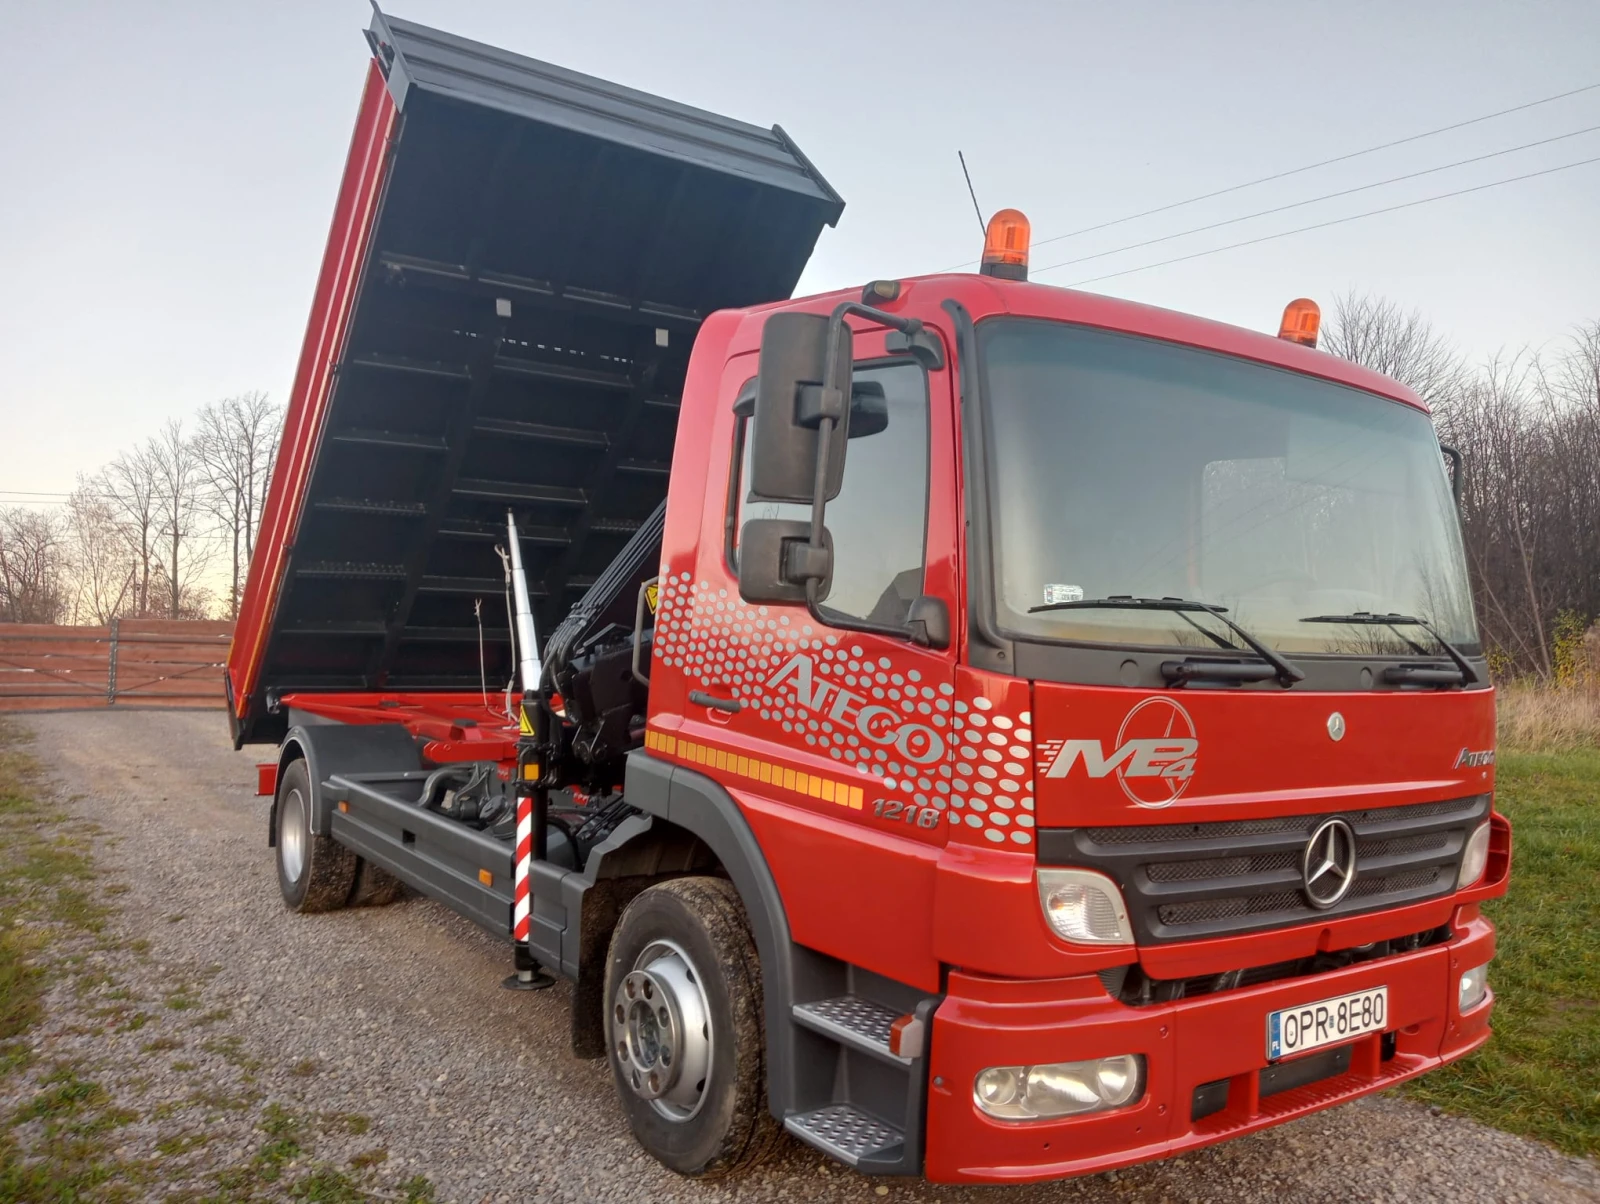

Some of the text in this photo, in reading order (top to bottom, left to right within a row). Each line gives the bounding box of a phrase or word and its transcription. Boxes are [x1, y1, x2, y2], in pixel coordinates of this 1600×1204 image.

[765, 653, 945, 764] ATEGO
[871, 798, 940, 829] 1218
[1284, 992, 1384, 1049] OPR 8E80
